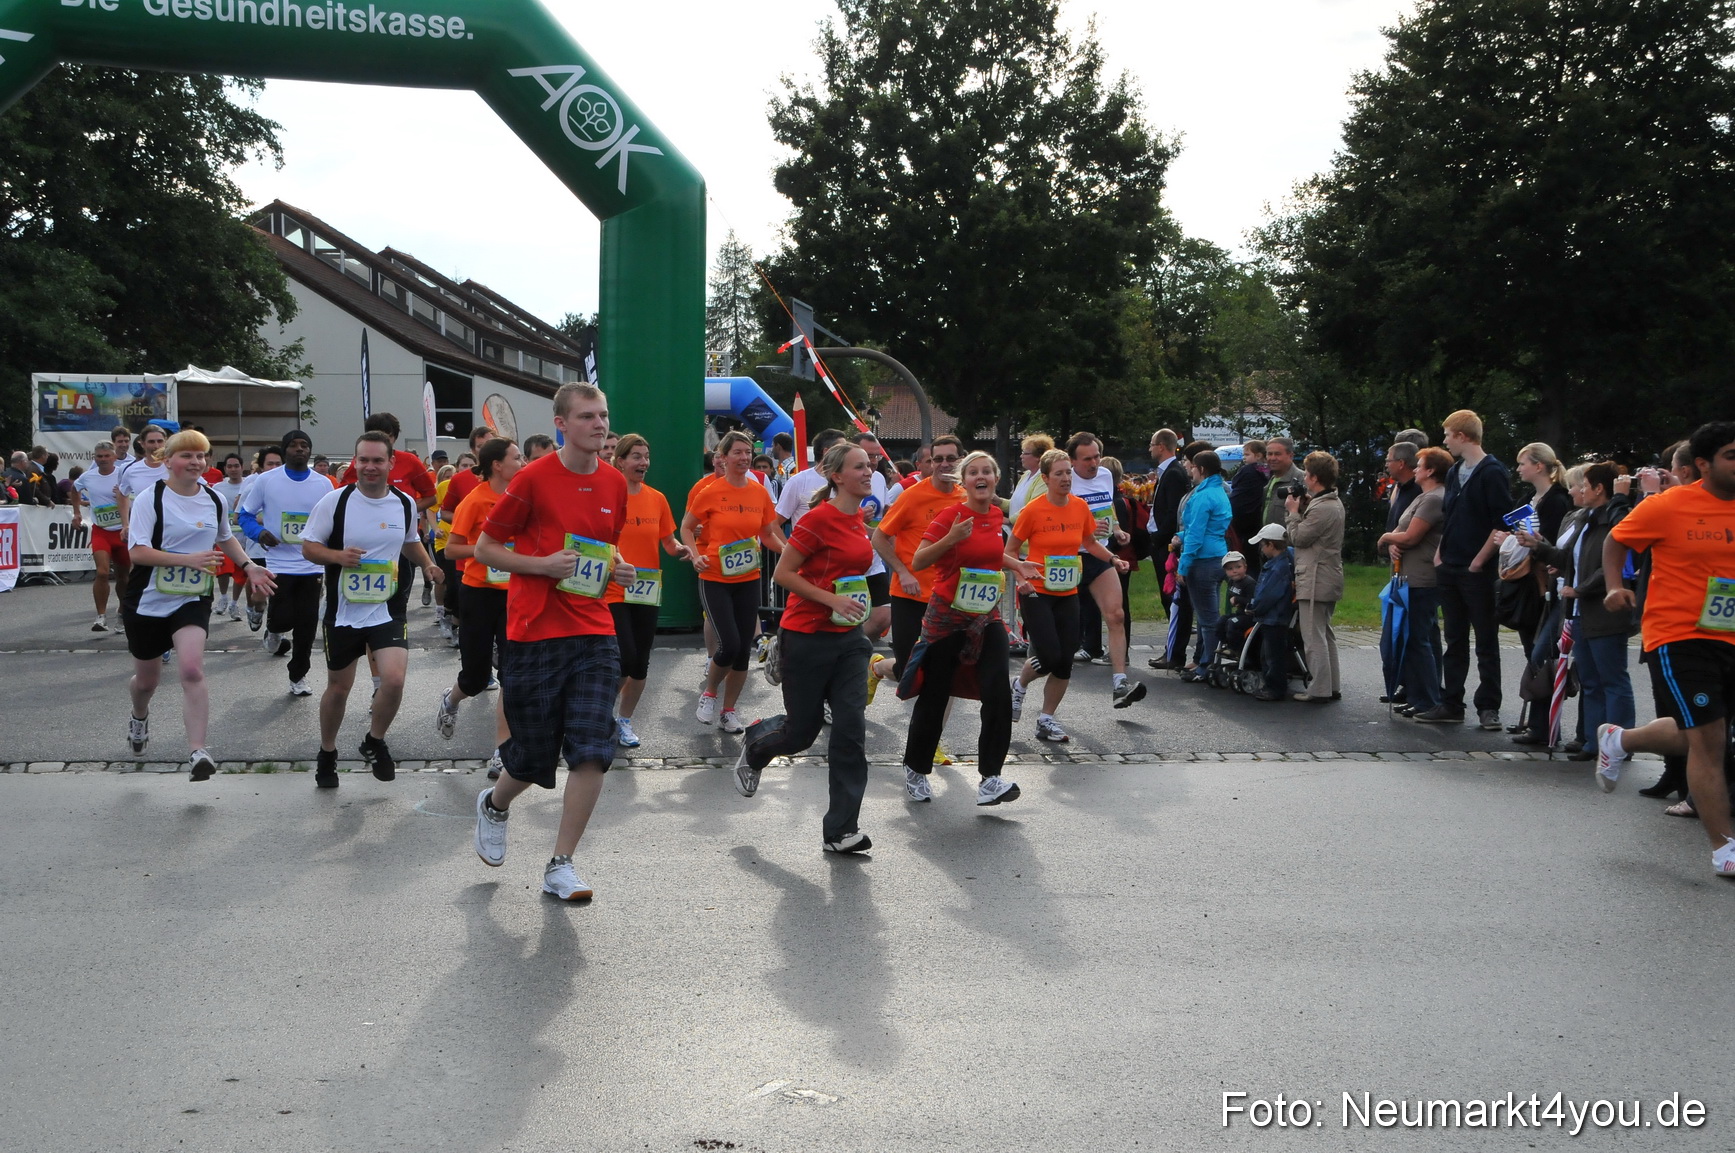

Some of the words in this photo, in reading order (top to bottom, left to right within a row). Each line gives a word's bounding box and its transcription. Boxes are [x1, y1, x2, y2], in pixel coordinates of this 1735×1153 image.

[143, 0, 474, 40] Gesundheitskasse.
[507, 65, 664, 195] AOK
[44, 394, 92, 410] TLA
[97, 510, 121, 522] 1028
[1687, 529, 1723, 541] EURO
[724, 549, 753, 569] 625
[163, 566, 202, 585] 313
[348, 573, 386, 592] 314
[1049, 567, 1074, 582] 591
[959, 583, 997, 603] 1143
